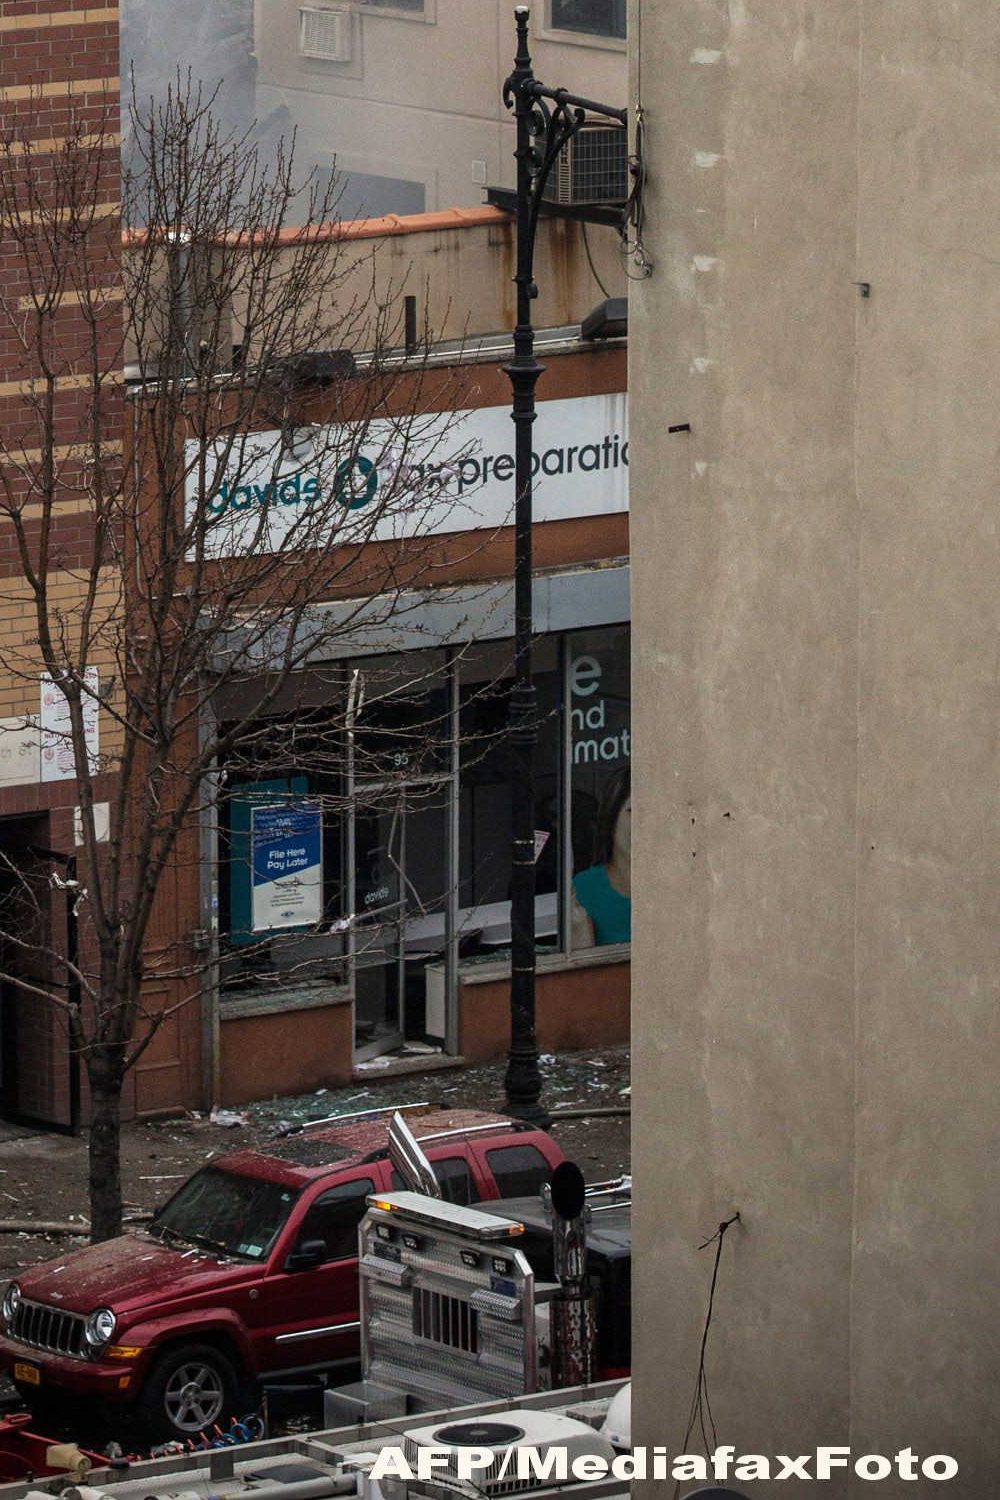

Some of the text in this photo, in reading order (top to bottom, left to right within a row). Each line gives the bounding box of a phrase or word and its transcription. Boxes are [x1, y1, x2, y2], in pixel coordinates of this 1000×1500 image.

[269, 847, 306, 860] File Here
[267, 857, 308, 871] Pay Later
